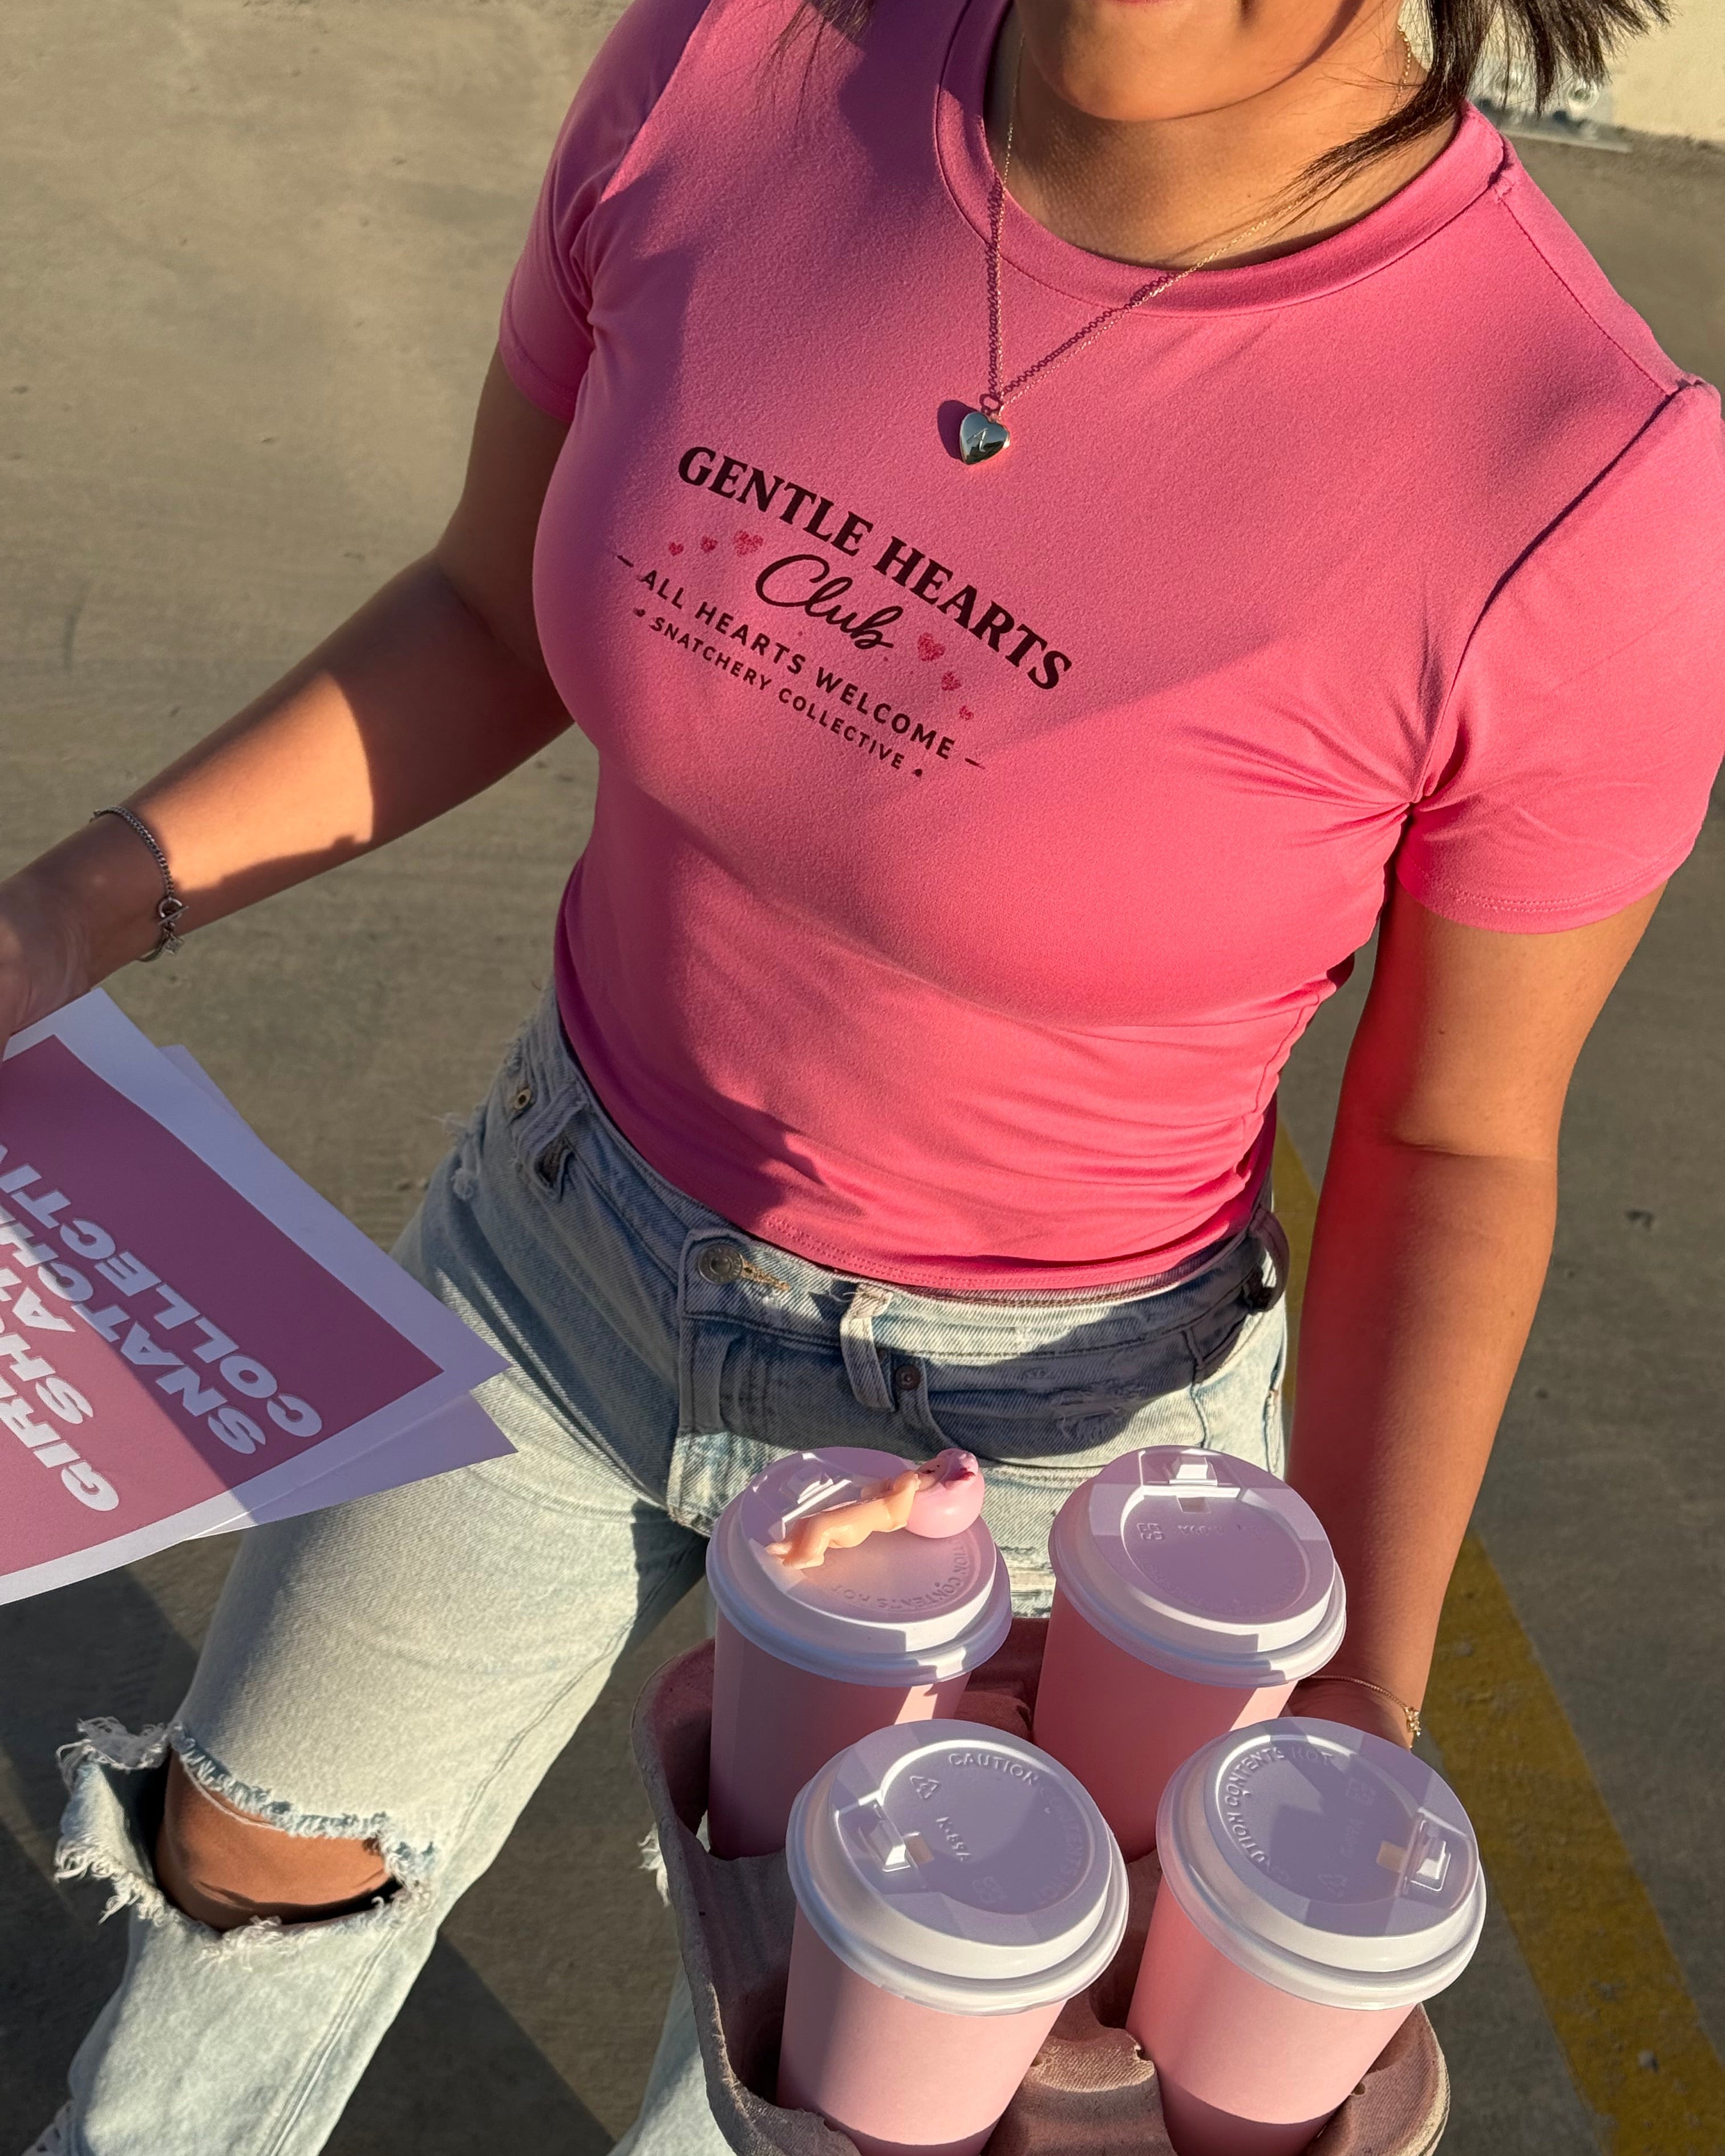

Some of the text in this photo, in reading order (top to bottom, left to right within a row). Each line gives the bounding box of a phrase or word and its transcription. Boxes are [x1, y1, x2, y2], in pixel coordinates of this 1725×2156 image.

[678, 446, 1072, 690] GENTLE HEARTS
[755, 554, 904, 650] Club
[640, 570, 955, 760] ALL HEARTS WELCOME
[651, 617, 904, 769] SNATCHERY COLLECTIVE
[0, 1143, 322, 1437] COLLECTI
[0, 1202, 266, 1454] SNATCH
[0, 1317, 94, 1425] SH
[877, 1578, 962, 1609] CONTENTS
[947, 1751, 1039, 1786] CAUTION
[1225, 1746, 1285, 1806] CONTENTS
